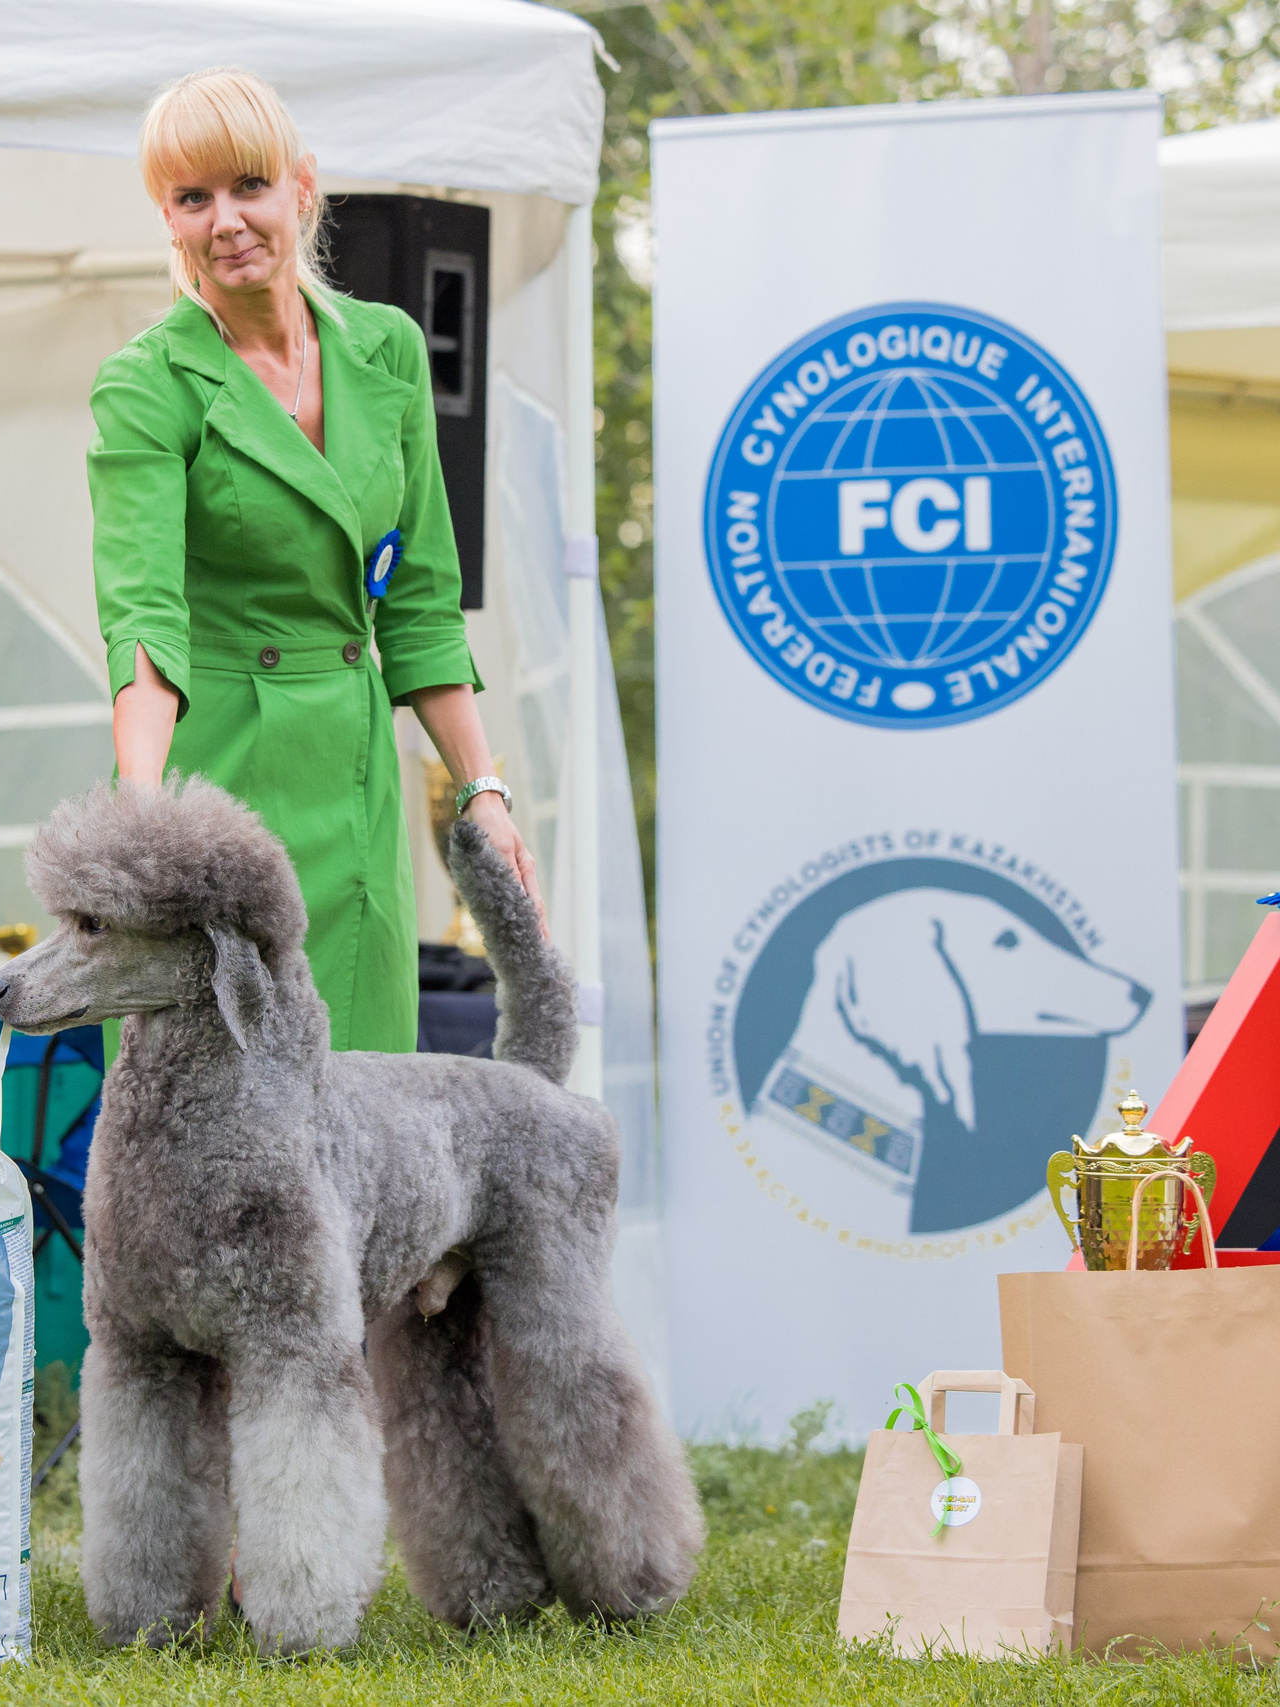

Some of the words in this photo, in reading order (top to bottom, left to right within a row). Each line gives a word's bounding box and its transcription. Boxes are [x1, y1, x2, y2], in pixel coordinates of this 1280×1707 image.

[740, 325, 1009, 467] CYNOLOGIQUE
[726, 490, 883, 709] FEDERATION
[838, 475, 992, 556] FCI
[943, 373, 1096, 708] INTERNANIONALE
